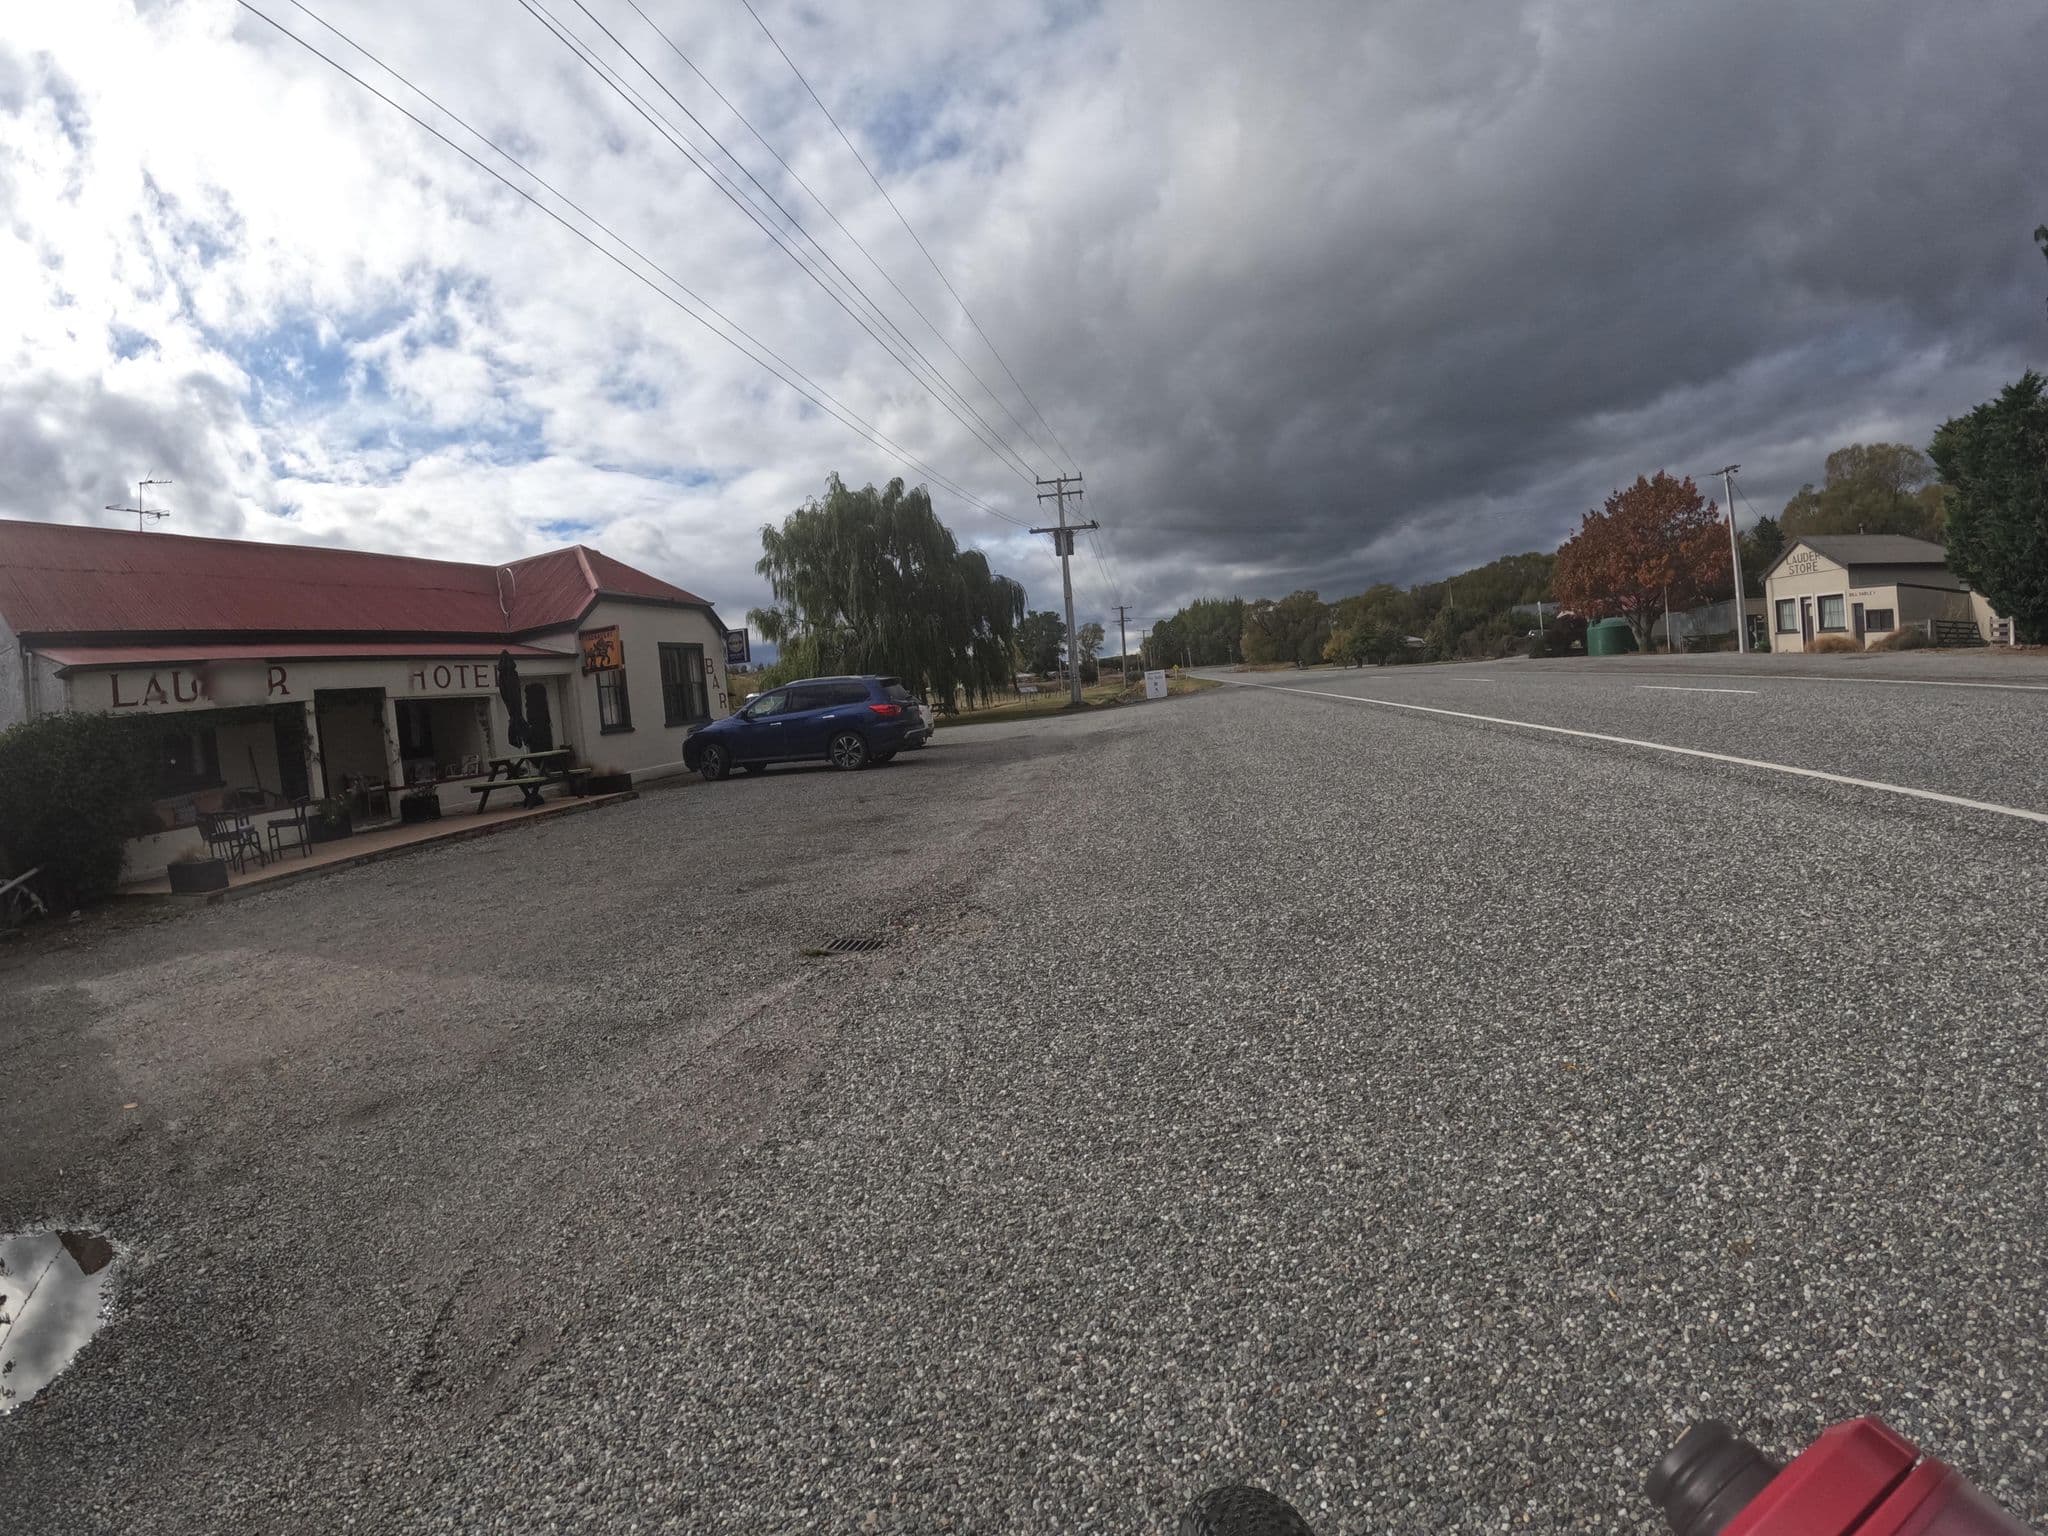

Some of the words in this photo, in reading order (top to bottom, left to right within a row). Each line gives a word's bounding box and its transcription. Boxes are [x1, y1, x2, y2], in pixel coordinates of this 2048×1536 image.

[1789, 561, 1818, 575] STORE
[110, 666, 290, 707] LAUR
[704, 658, 727, 708] BAR
